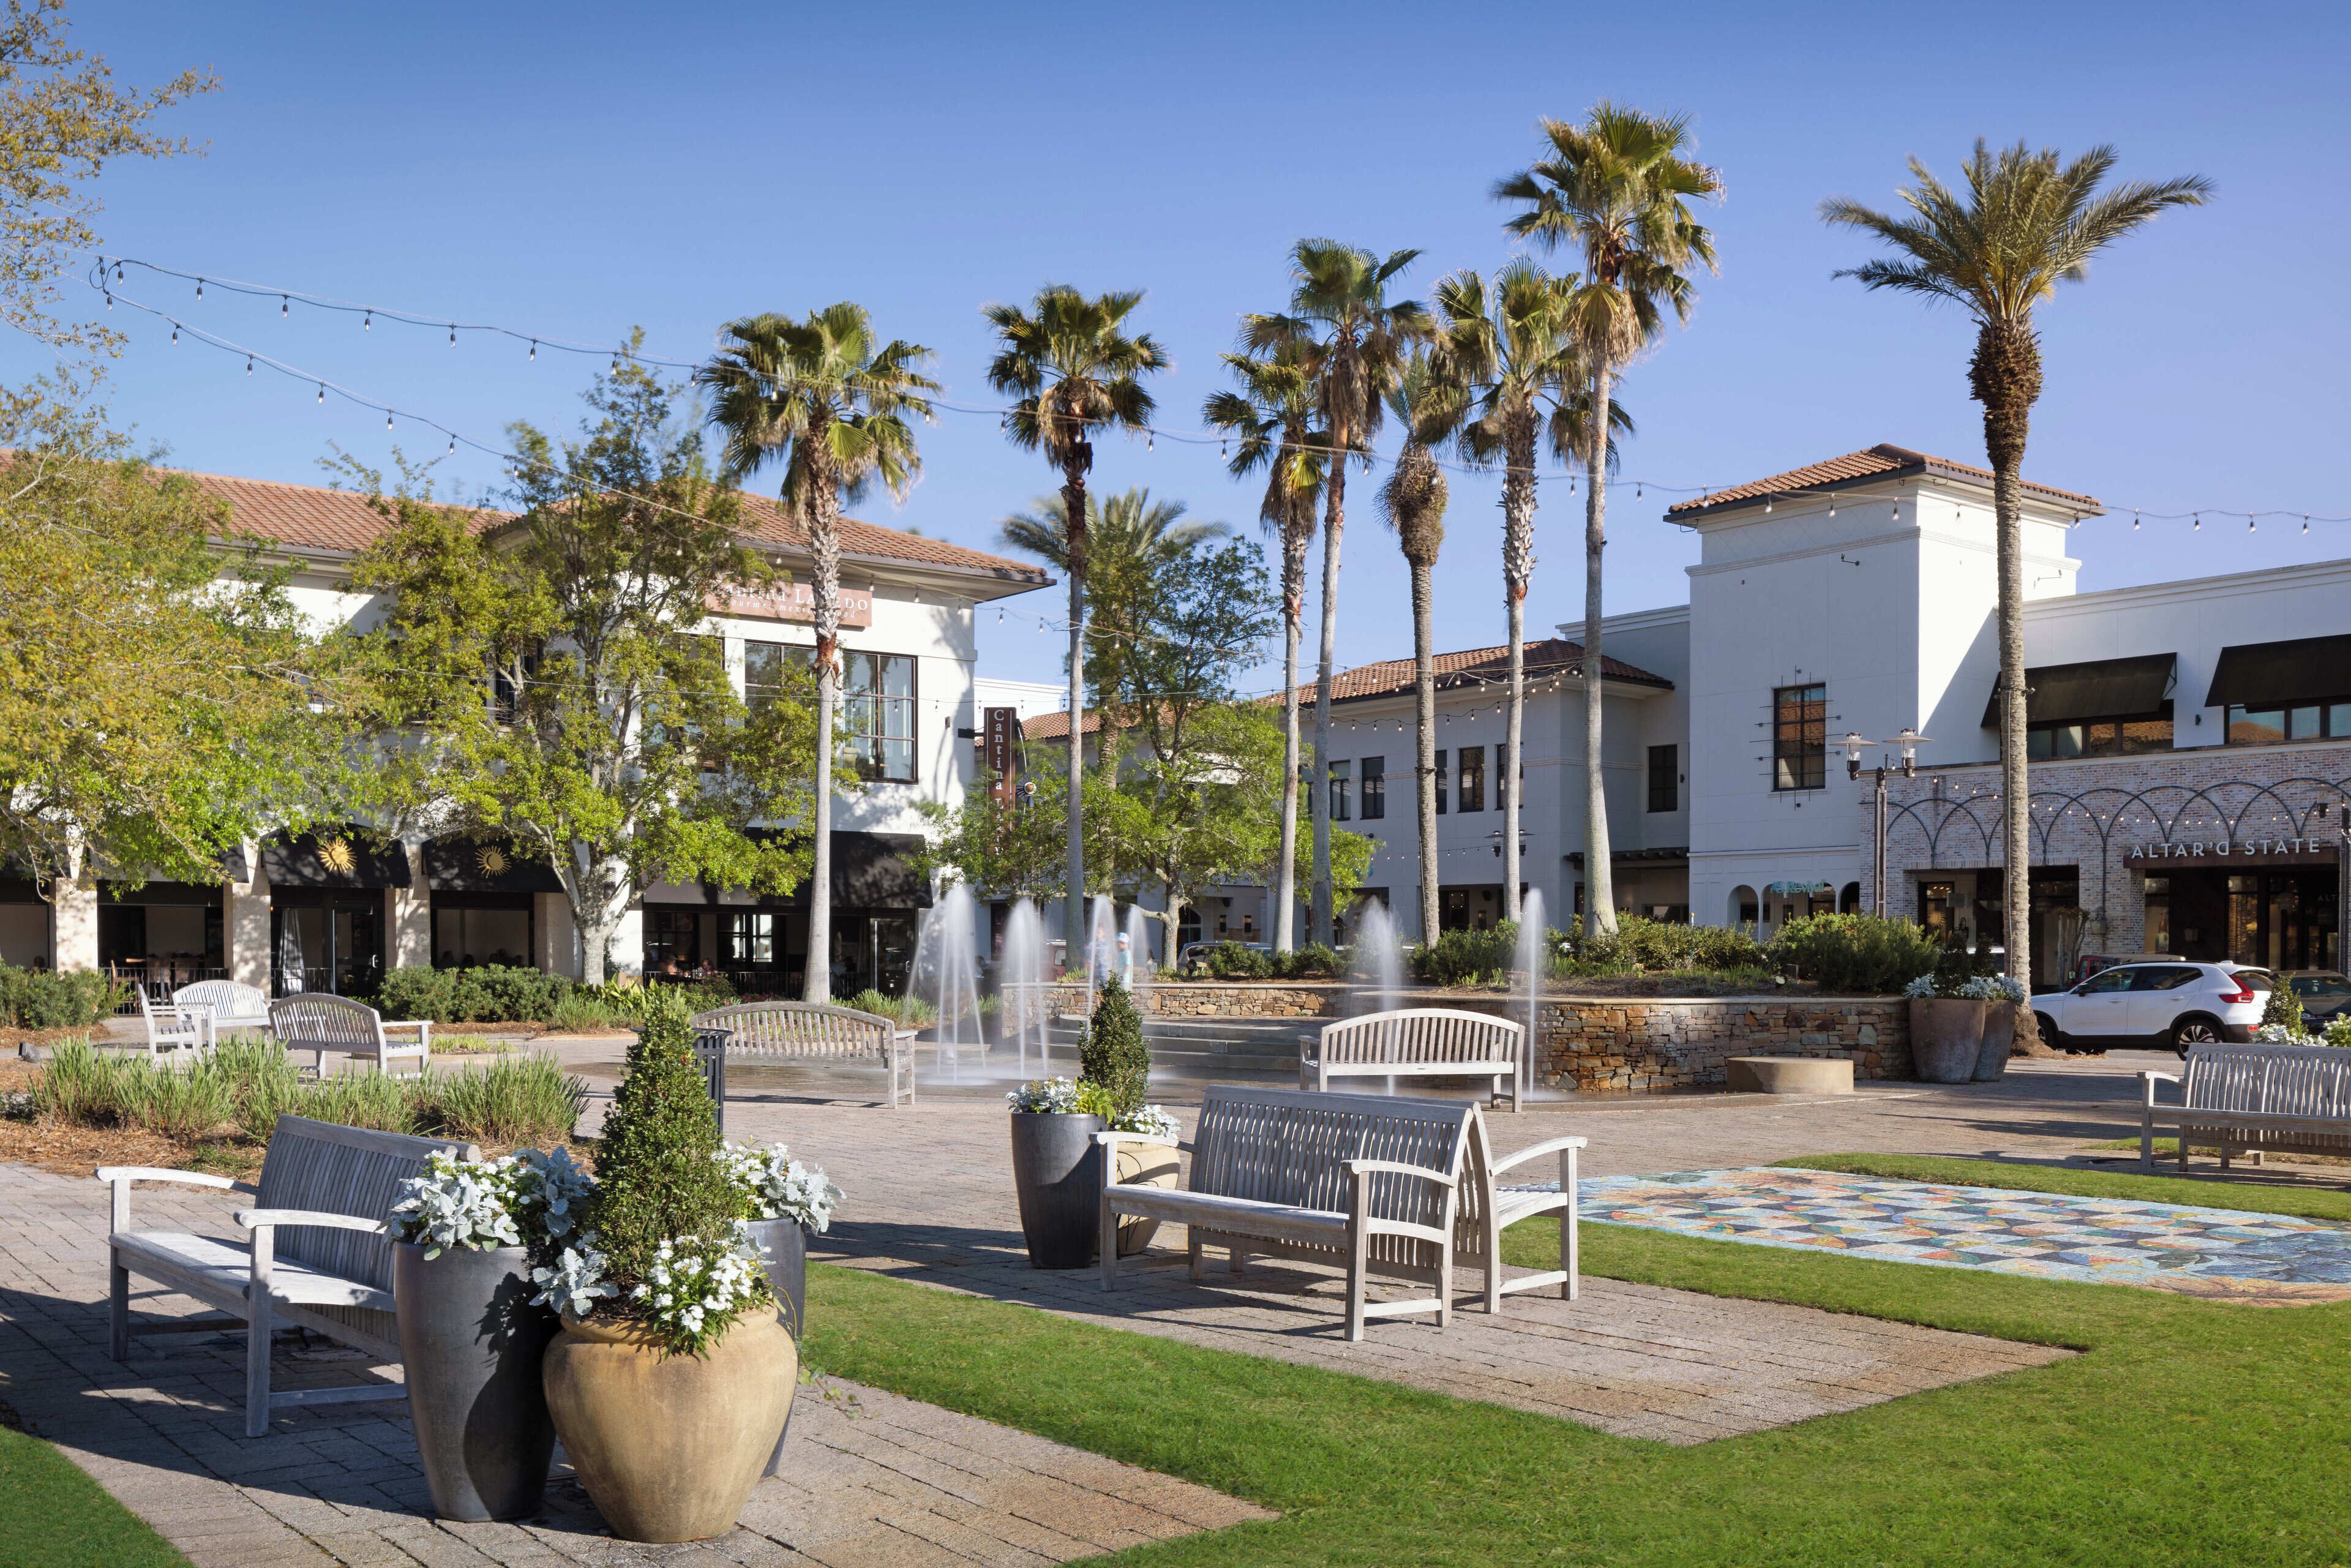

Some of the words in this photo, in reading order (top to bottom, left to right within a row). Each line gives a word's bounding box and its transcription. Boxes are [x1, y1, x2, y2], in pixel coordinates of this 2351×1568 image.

[710, 579, 786, 602] antina
[794, 588, 868, 610] LAEDO
[994, 709, 1004, 790] Cantina
[2244, 838, 2320, 855] STATE
